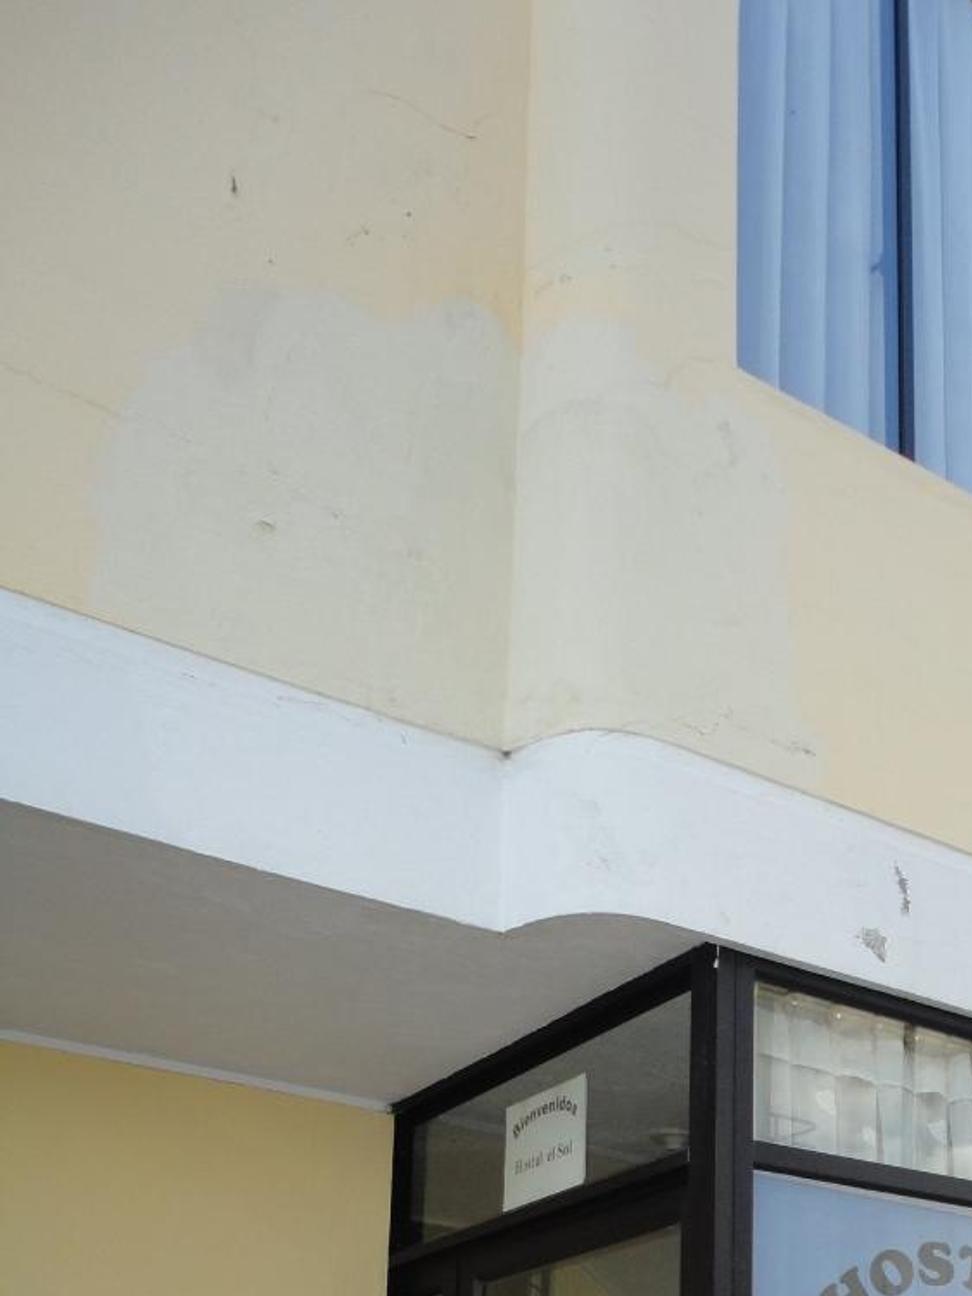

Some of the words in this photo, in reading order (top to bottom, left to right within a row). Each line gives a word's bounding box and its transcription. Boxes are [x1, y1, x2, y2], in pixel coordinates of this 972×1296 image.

[513, 1095, 578, 1140] Bienvenidos
[514, 1151, 544, 1176] Hostal
[547, 1146, 556, 1162] el
[557, 1139, 574, 1160] Sol
